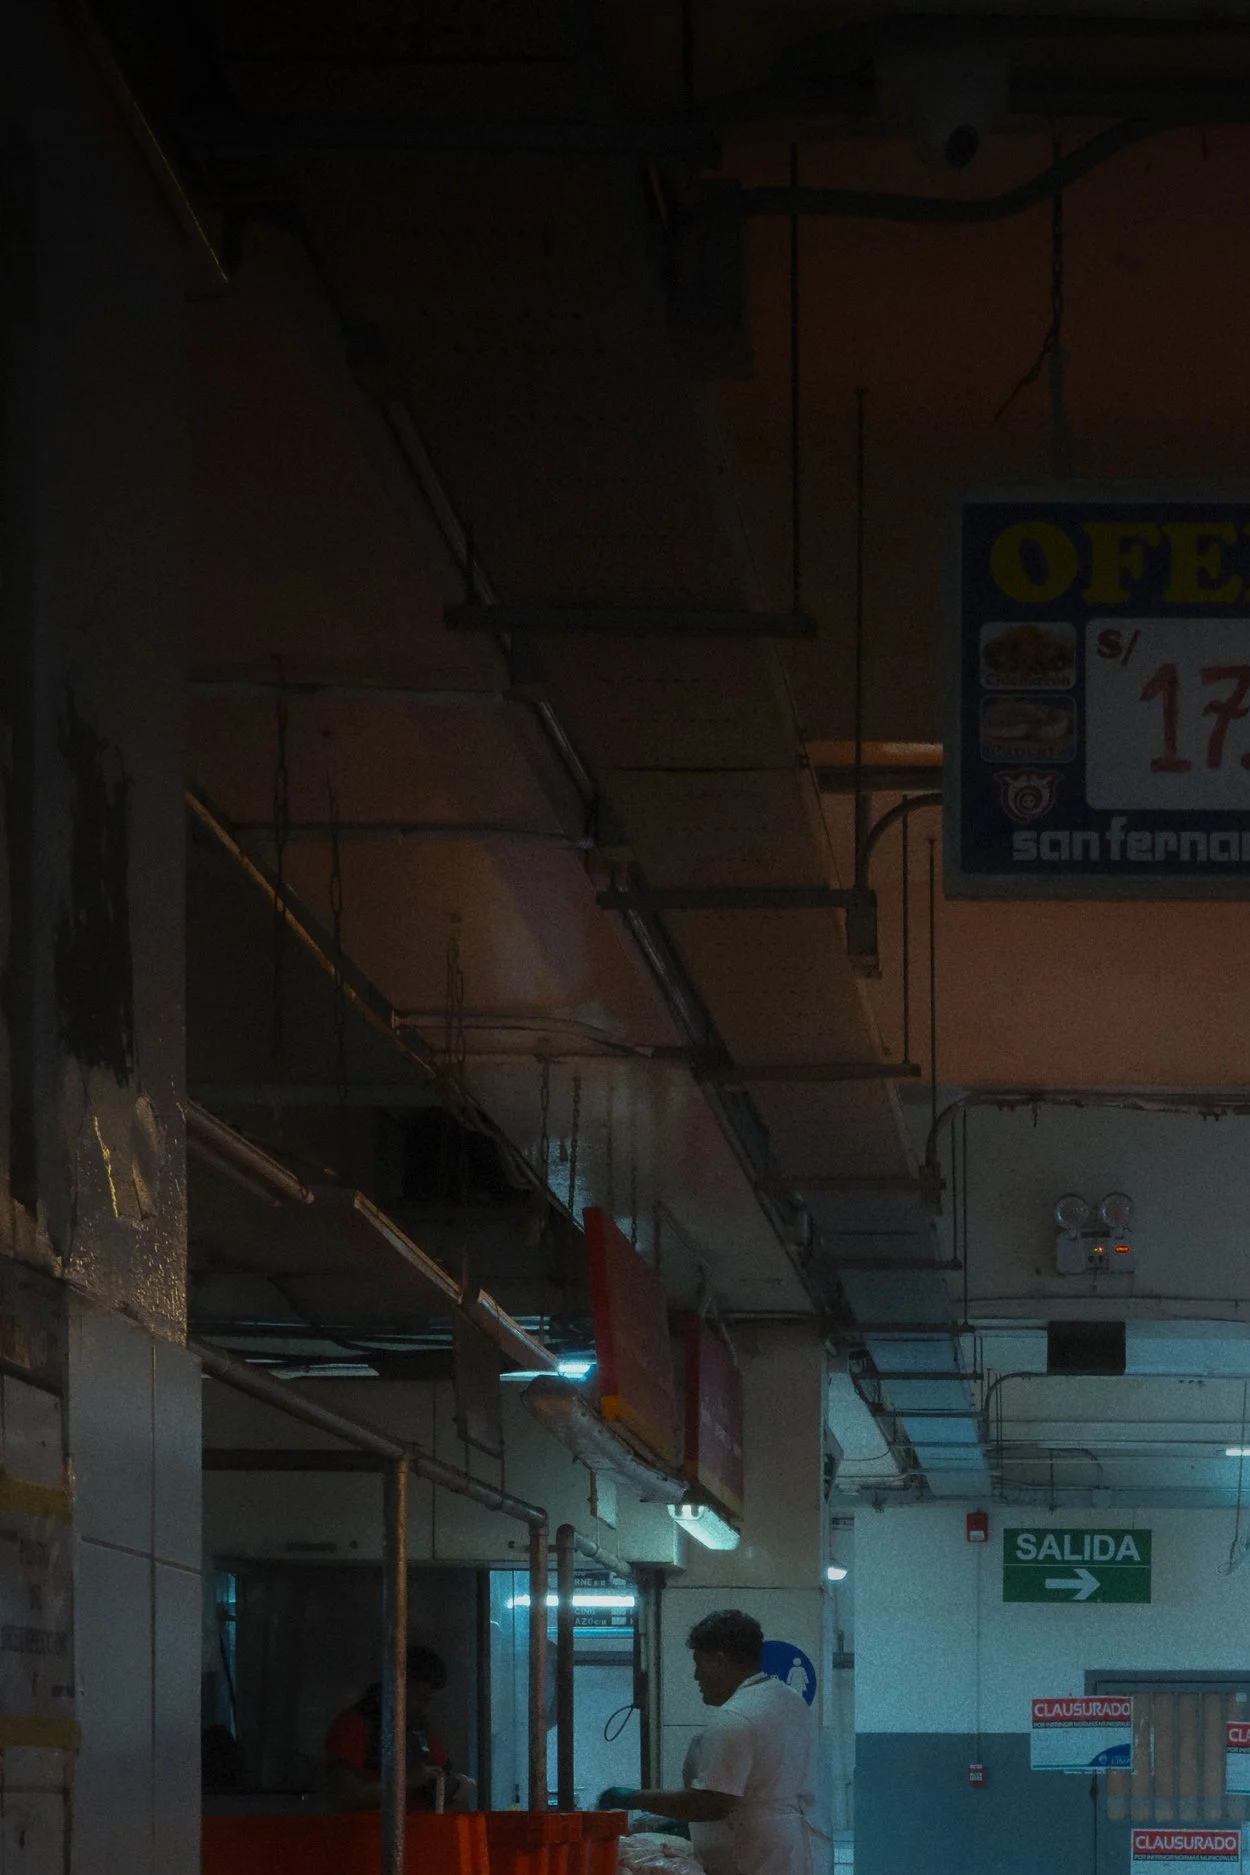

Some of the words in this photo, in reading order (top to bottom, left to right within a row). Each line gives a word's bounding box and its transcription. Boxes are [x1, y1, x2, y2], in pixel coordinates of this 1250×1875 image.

[1096, 627, 1141, 666] S/
[1015, 1533, 1141, 1562] SALIDA
[1034, 1702, 1131, 1717] CLAUSURADO
[1135, 1835, 1237, 1850] CLAUSURADO
